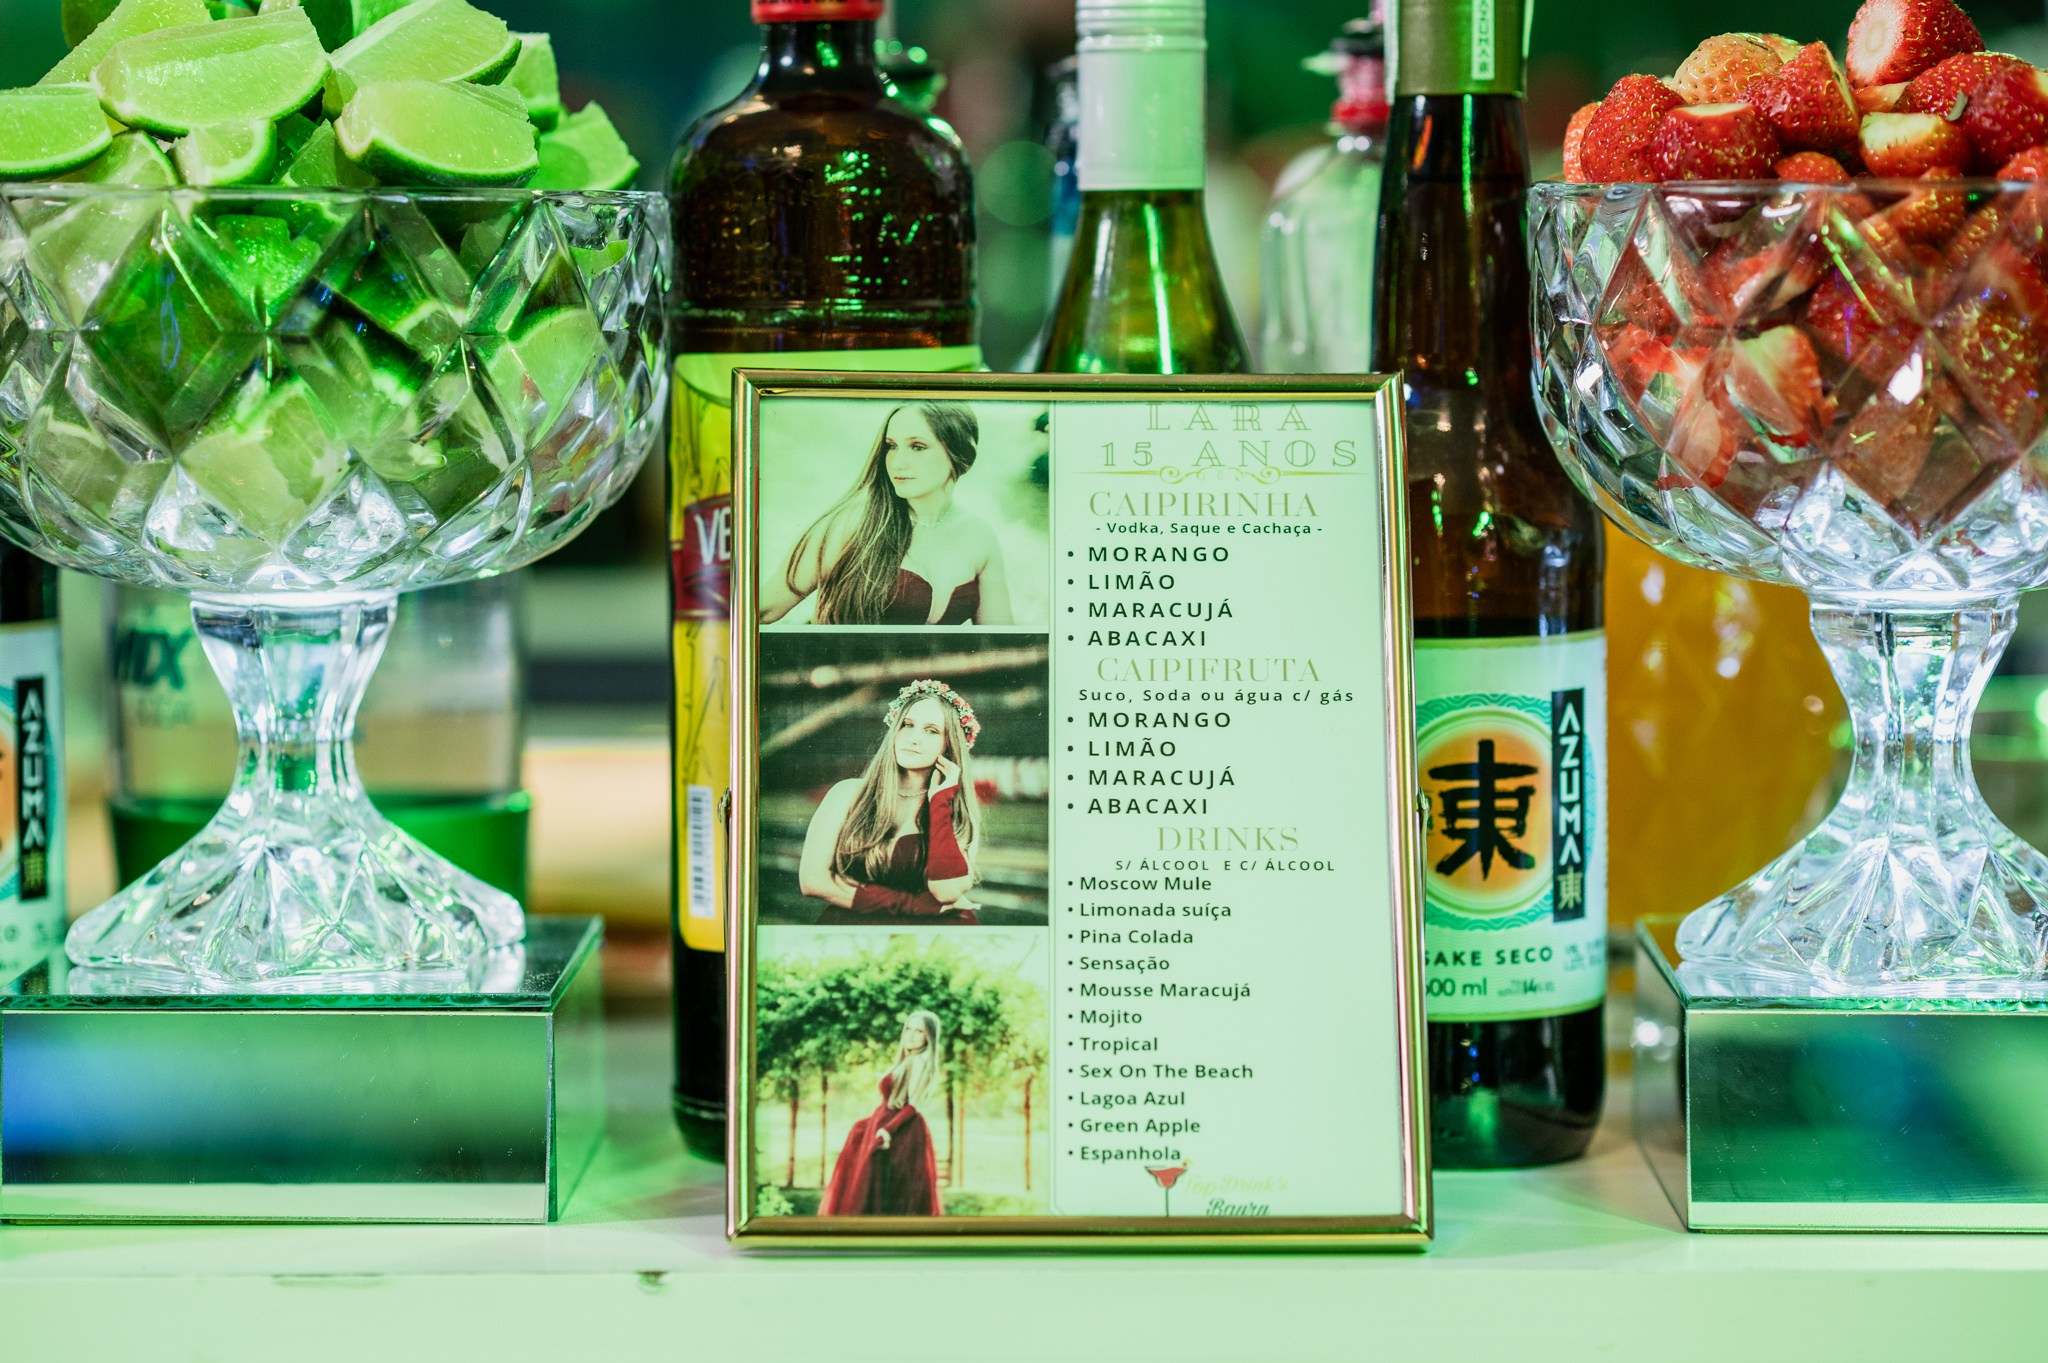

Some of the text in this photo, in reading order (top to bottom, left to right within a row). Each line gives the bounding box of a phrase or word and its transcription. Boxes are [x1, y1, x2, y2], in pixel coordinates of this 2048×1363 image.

[1146, 404, 1311, 431] LARA
[1101, 440, 1357, 467] 15 ANOS
[1089, 491, 1319, 517] CAIPIRINHA
[1107, 522, 1164, 535] Vodka,
[1170, 522, 1221, 537] Saque
[1227, 525, 1236, 534] e
[1242, 522, 1311, 537] Cachaça
[1088, 546, 1229, 562] MORANGO
[1088, 571, 1175, 590] LIMÃO
[1088, 599, 1233, 621] MARACUJÁ
[1088, 630, 1206, 646] ABACAXI
[1097, 657, 1321, 682] CAIPIFRUTA
[1079, 689, 1354, 705] Suco, Soda ou água c/ gás
[1088, 712, 1231, 728] MORANGO
[1088, 737, 1176, 757] LIMÃO
[21, 687, 45, 849] AZUMA
[1088, 766, 1235, 789] MARACUJÁ
[1558, 702, 1581, 866] AZUMA
[1088, 798, 1208, 814] ABACAXI
[1428, 739, 1539, 881] 東
[1157, 827, 1299, 851] DRINKS
[1115, 857, 1335, 871] S/ ÁLCOOL E C/ ÁLCOOL
[1080, 877, 1212, 891] Moscow Mule
[1080, 903, 1232, 921] Limonada suíça
[1080, 930, 1193, 944] Pina Colada
[1495, 946, 1553, 965] SECO
[1080, 956, 1170, 974] Sensação
[1080, 983, 1251, 1001] Mousse Maracujá
[1425, 977, 1456, 997] 00
[1462, 977, 1487, 996] ml
[1080, 1010, 1142, 1028] Mojito
[1080, 1037, 1158, 1055] Tropical
[1080, 1064, 1253, 1078] Sex On The Beach
[1080, 1091, 1185, 1109] Lagoa Azul
[1080, 1118, 1201, 1136] Green Apple
[1080, 1146, 1181, 1164] Espanhola
